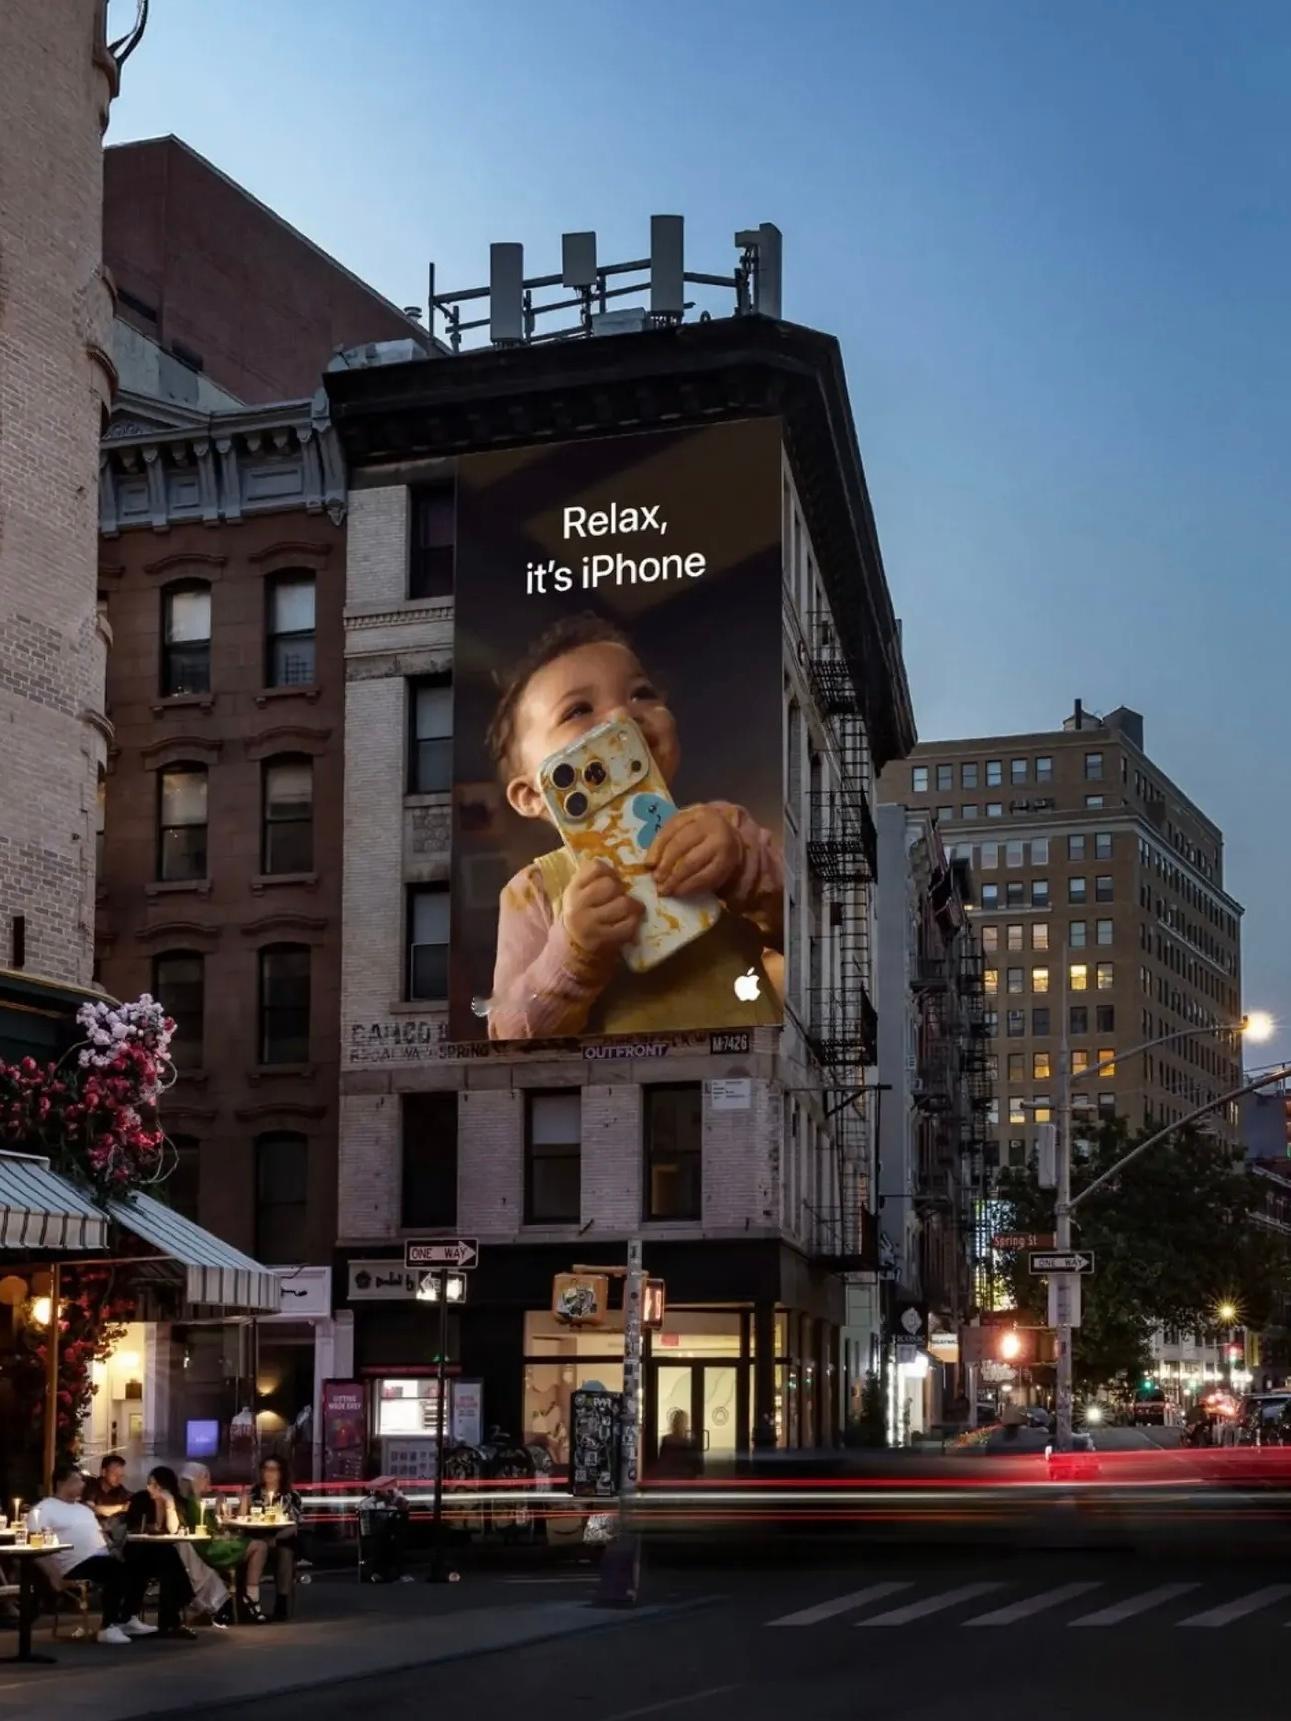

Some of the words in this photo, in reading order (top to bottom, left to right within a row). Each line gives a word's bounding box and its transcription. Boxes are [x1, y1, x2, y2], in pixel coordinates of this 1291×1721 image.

[563, 502, 667, 539] Relax,
[526, 560, 573, 594] it's
[582, 552, 706, 589] iPhone
[584, 1043, 667, 1058] OUTFRONT
[994, 1235, 1025, 1250] Spring
[1028, 1234, 1037, 1246] St
[411, 1247, 432, 1259] ONE
[445, 1247, 467, 1258] WAY
[1039, 1258, 1057, 1268] ONE
[1065, 1257, 1083, 1267] WAY
